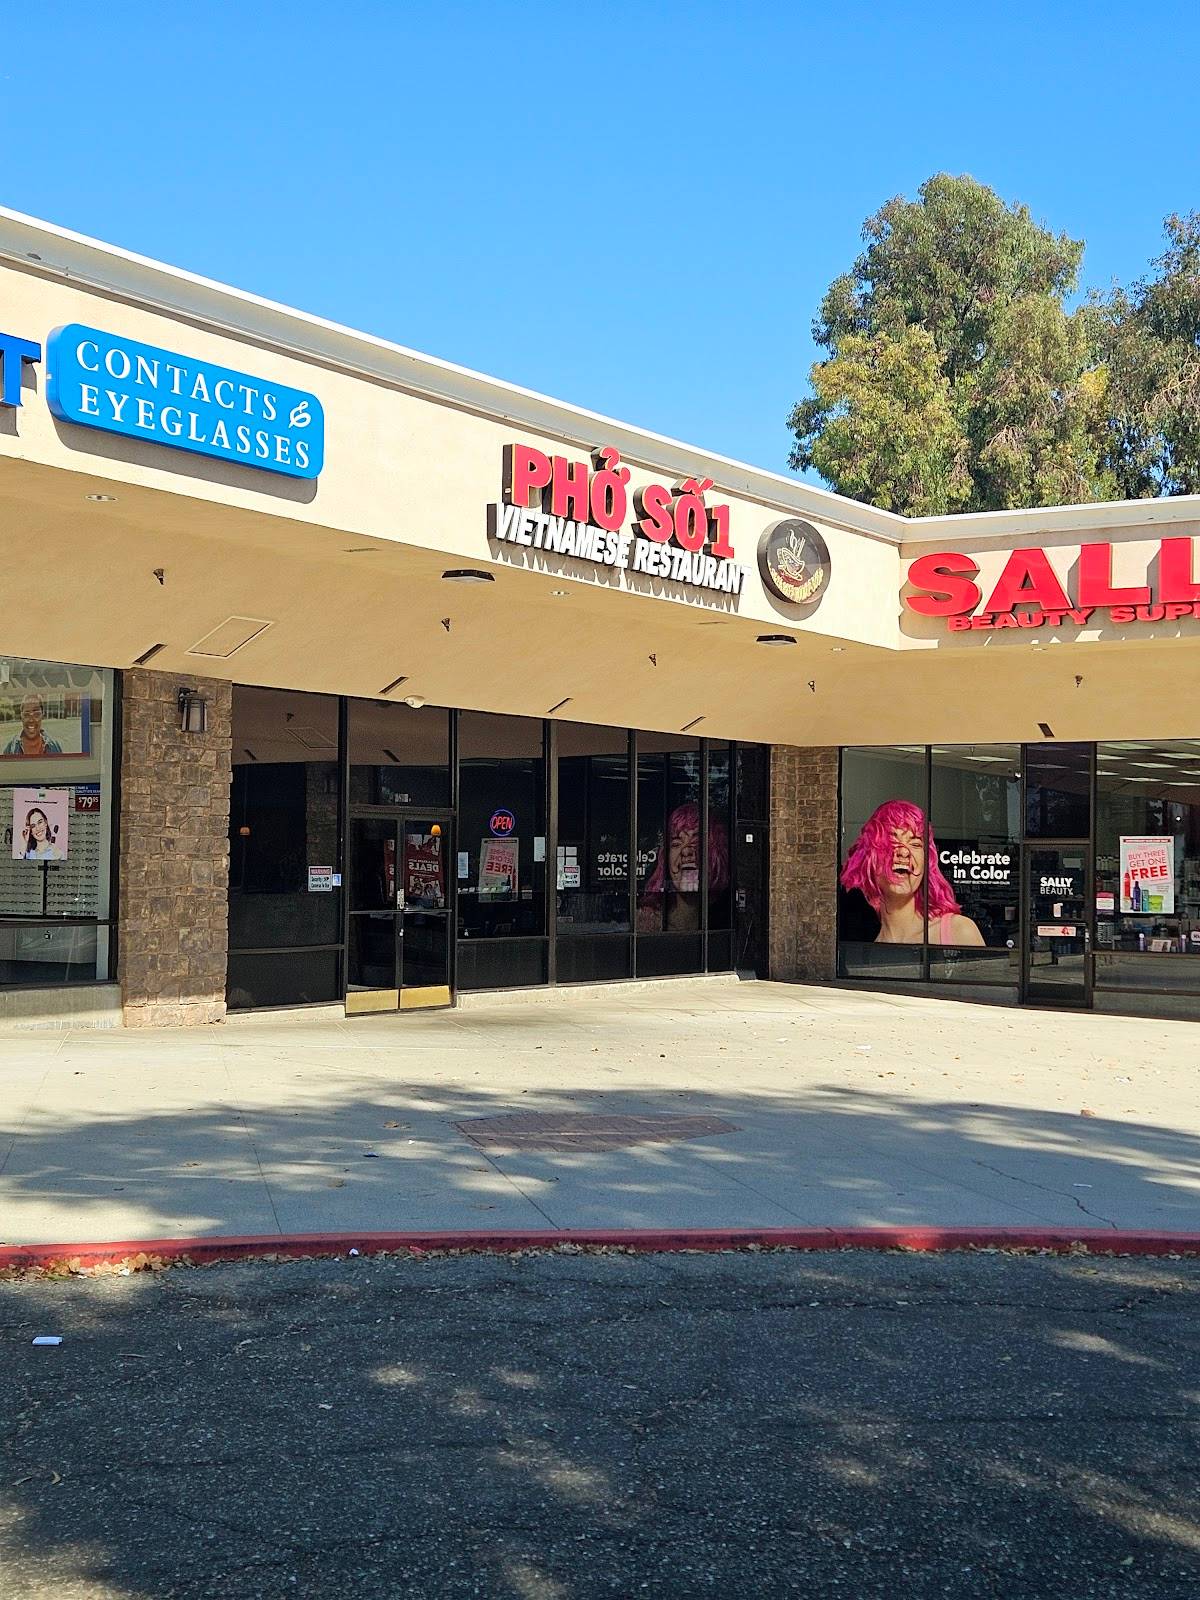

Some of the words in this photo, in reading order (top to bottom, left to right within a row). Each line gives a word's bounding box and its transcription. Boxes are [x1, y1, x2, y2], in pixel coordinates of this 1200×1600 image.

[76, 341, 277, 421] CONTACTS
[288, 400, 312, 428] &
[79, 383, 310, 469] EYEGLASSES
[511, 443, 631, 531] PHỞ
[496, 503, 632, 567] VIETNAMESE
[633, 538, 753, 595] RESTAURANT
[948, 608, 1095, 631] BEAUTY
[491, 816, 513, 829] OPEN
[940, 850, 1011, 865] Celebrate
[1128, 853, 1142, 861] BUY
[1144, 849, 1166, 858] THREE
[1129, 860, 1146, 868] GET
[1148, 857, 1166, 865] ONE
[953, 865, 966, 879] in
[970, 865, 1010, 879] Color
[1131, 865, 1168, 880] FREE
[1040, 876, 1074, 888] SALLY
